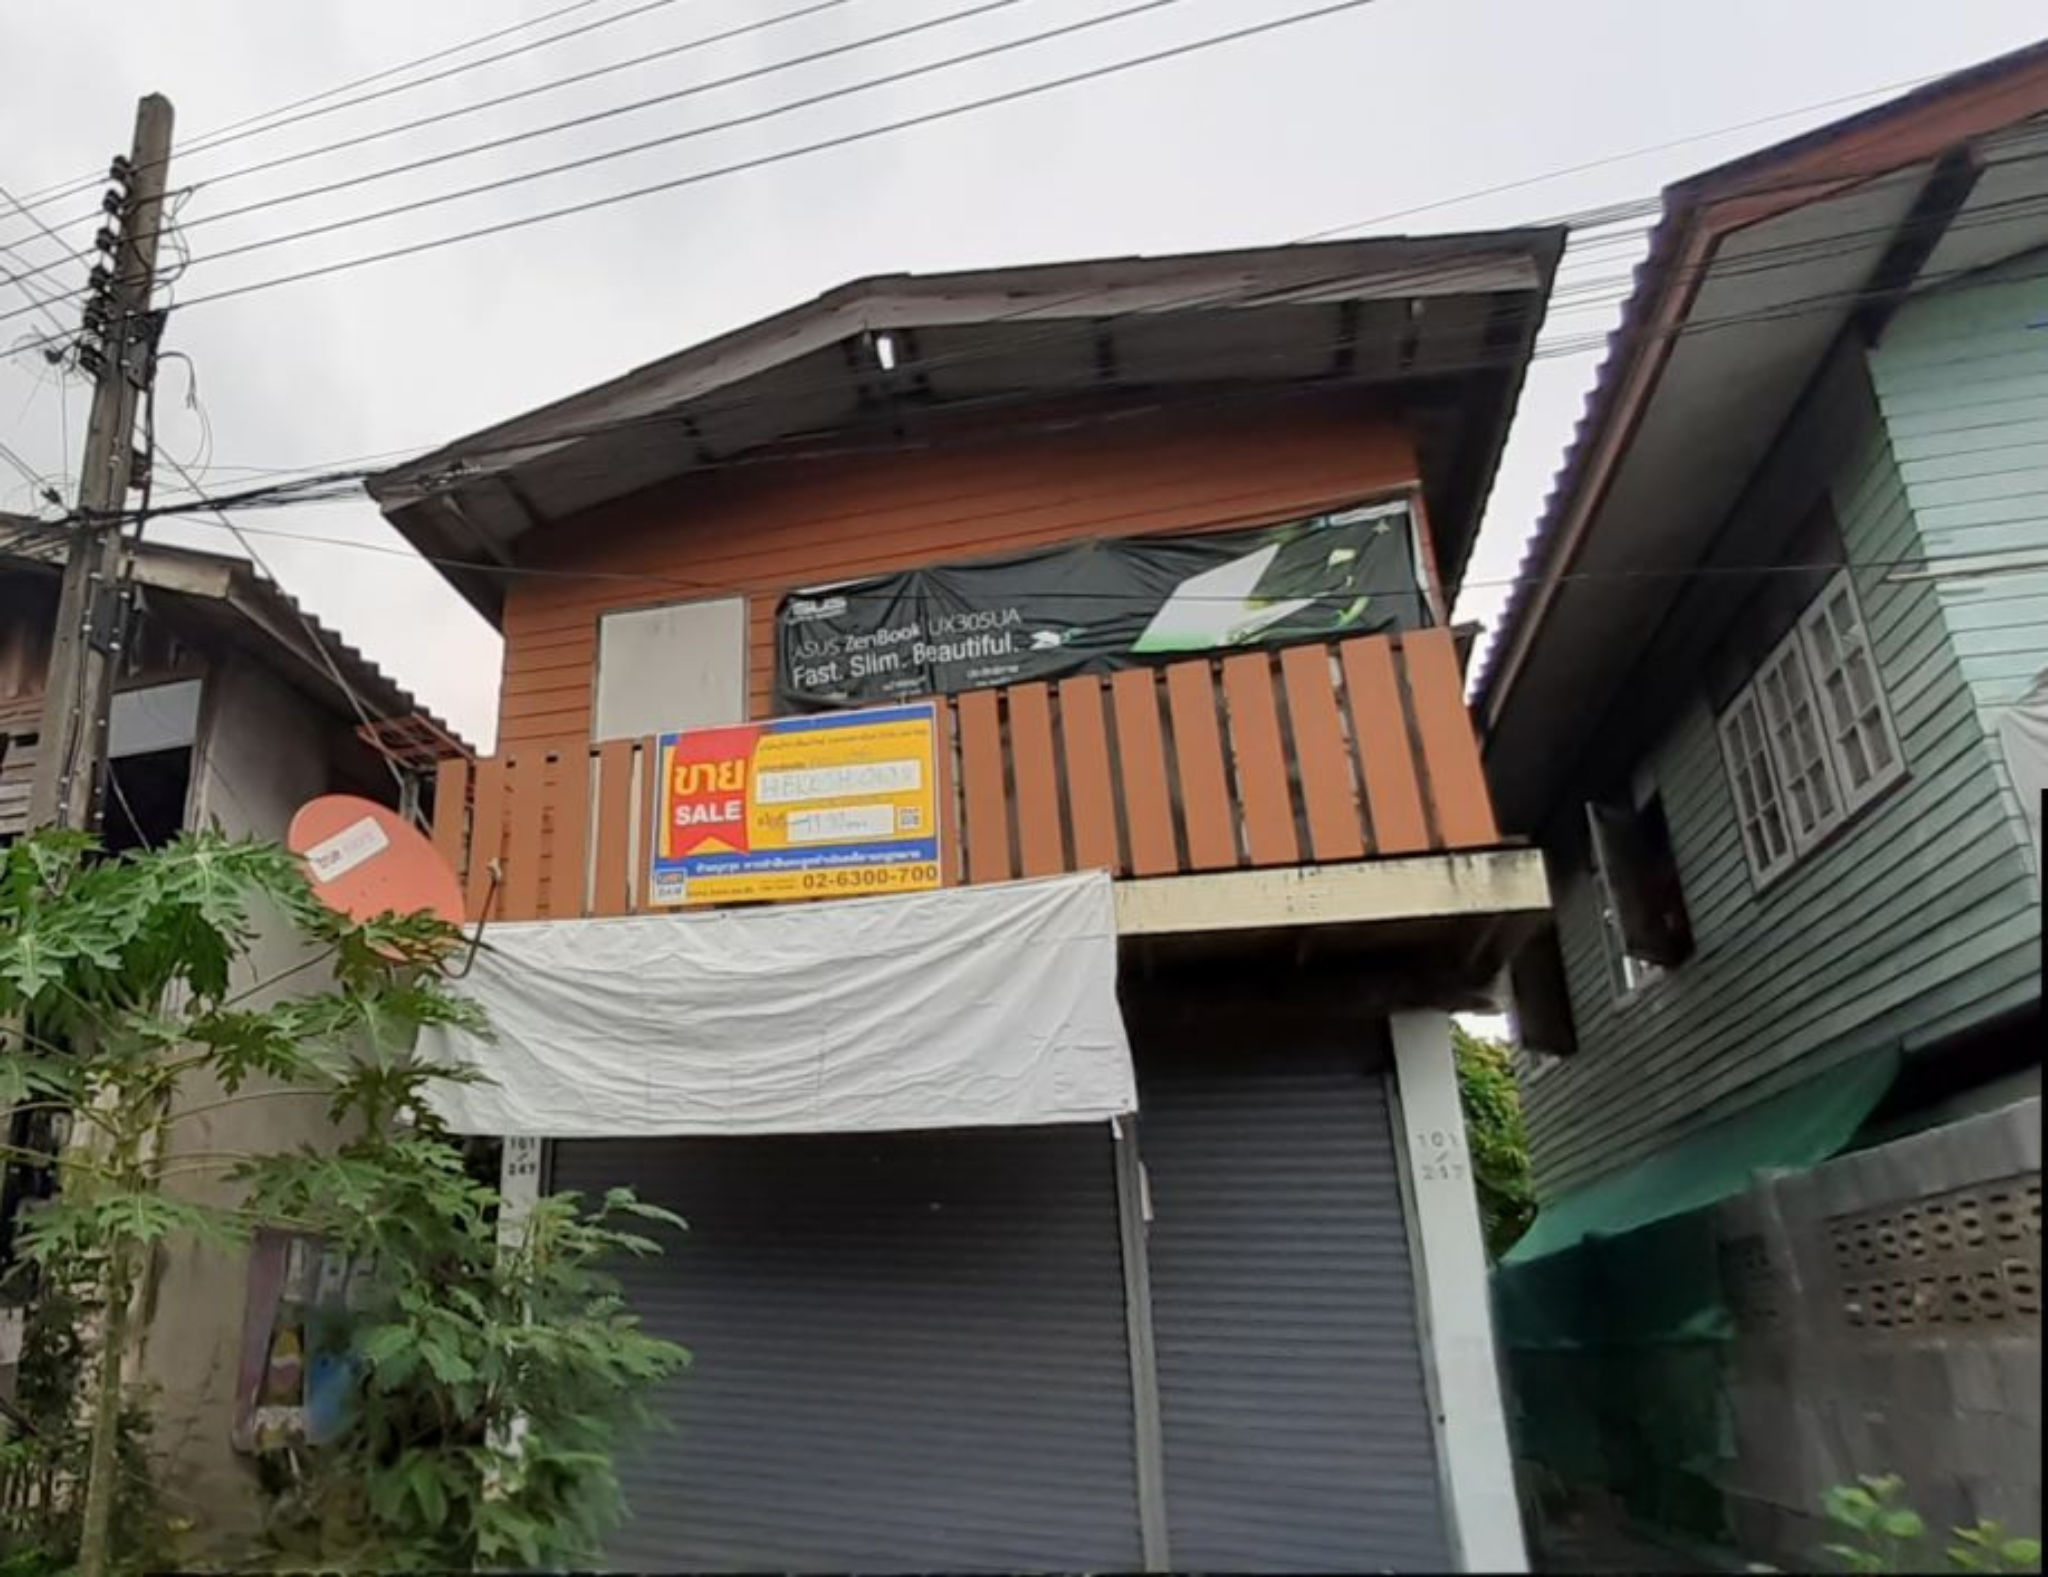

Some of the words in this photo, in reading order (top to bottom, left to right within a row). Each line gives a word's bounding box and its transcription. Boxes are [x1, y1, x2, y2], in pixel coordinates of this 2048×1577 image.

[794, 639, 841, 660] ASUS
[845, 622, 921, 652] ZenBook
[792, 662, 844, 688] Fast.
[850, 652, 908, 678] Slim.
[912, 632, 1021, 666] Beautiful.
[675, 759, 745, 796] ขาย
[676, 799, 742, 826] SALE
[802, 864, 938, 889] 02-6300-700
